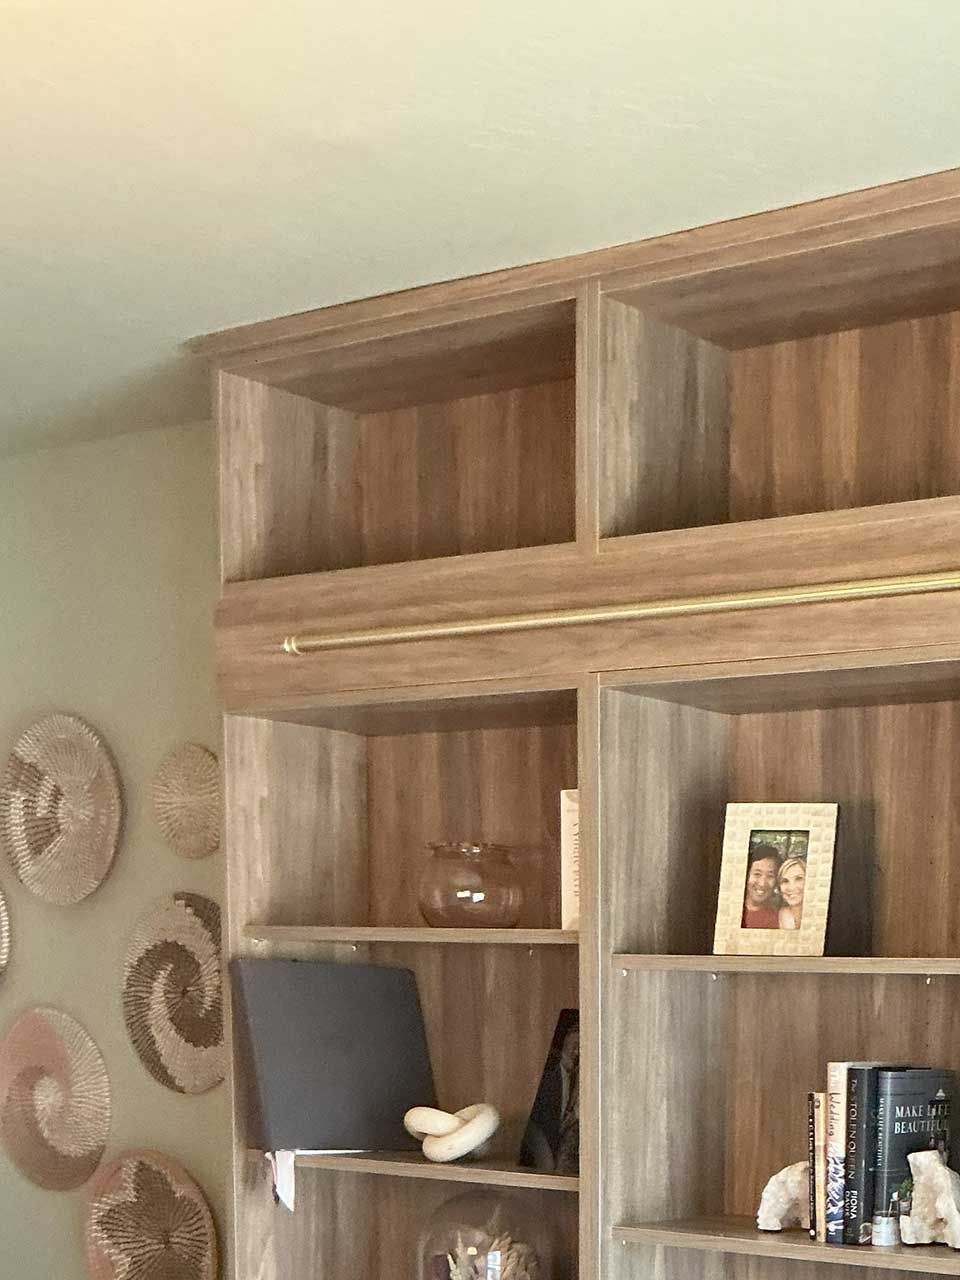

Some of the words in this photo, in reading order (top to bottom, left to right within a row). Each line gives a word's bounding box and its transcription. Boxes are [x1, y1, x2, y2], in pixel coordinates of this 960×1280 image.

[829, 1093, 840, 1137] Wedding
[849, 1096, 857, 1139] STOLEN
[894, 1118, 949, 1134] BEAUTIFUL
[895, 1105, 923, 1118] MAKE
[848, 1141, 857, 1179] QUEEN
[850, 1190, 858, 1219] FIONA
